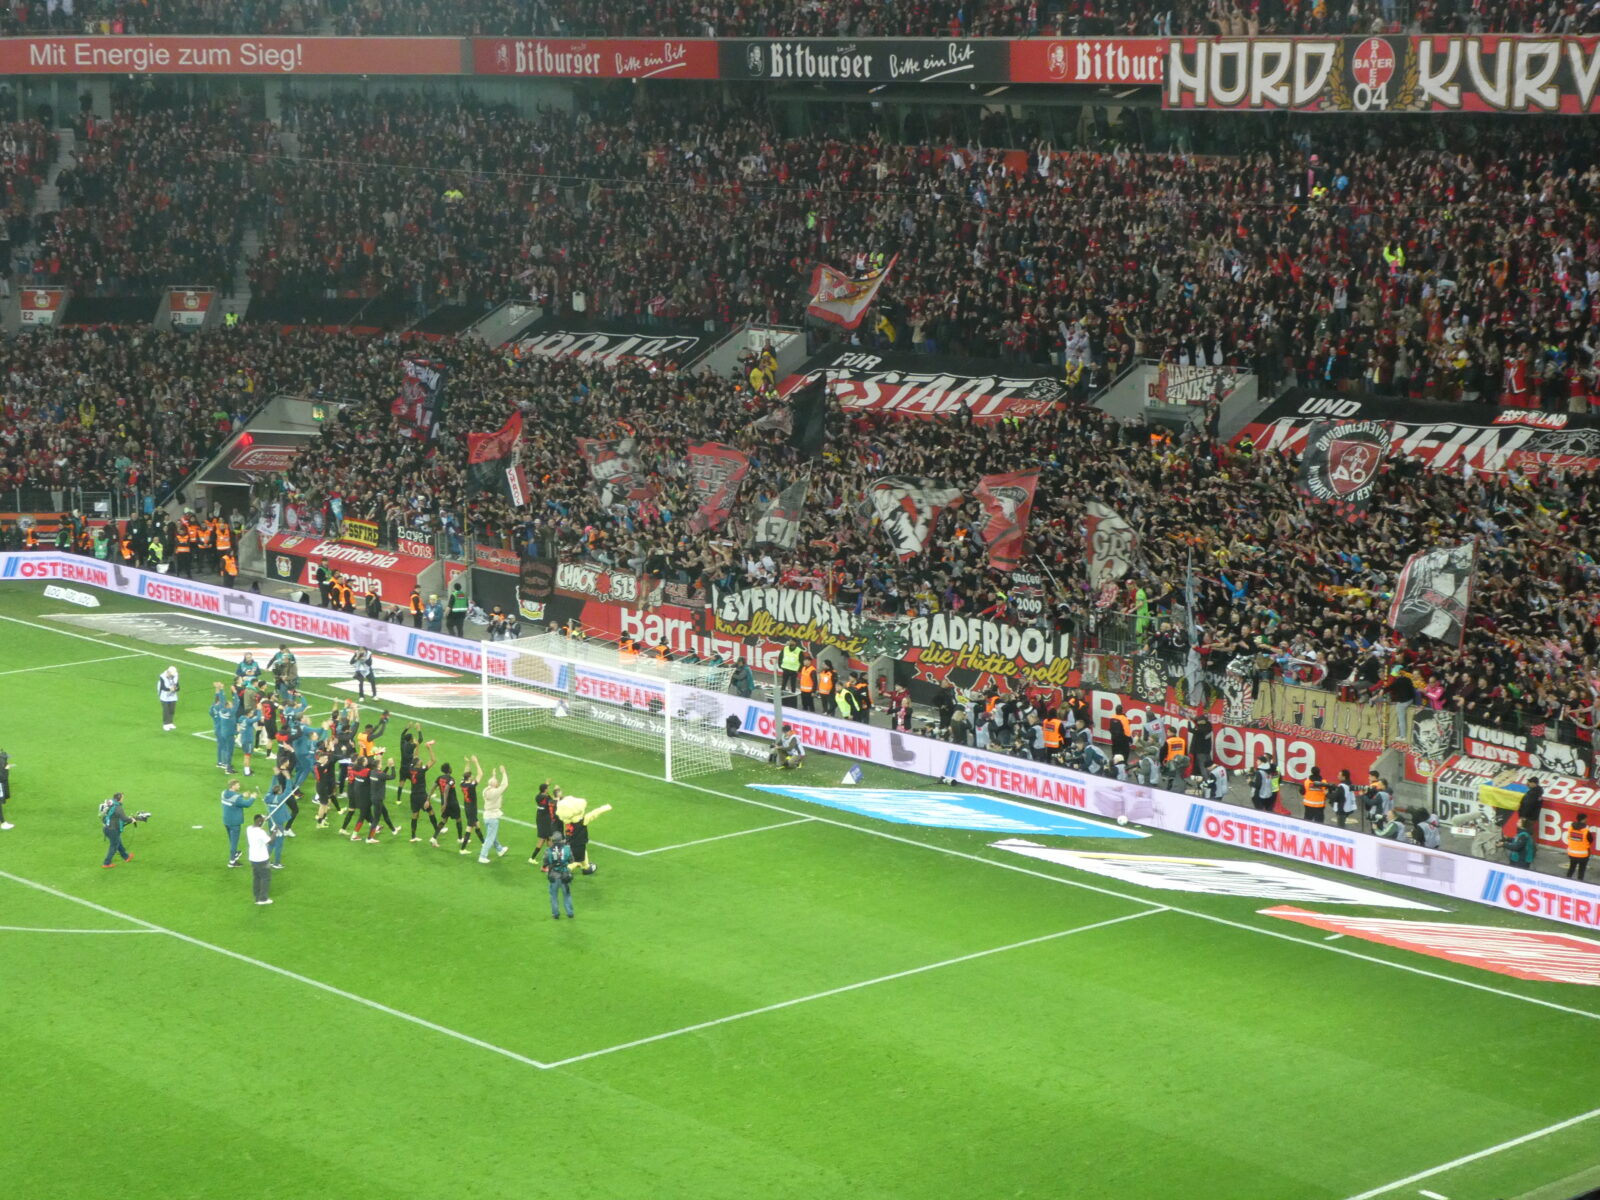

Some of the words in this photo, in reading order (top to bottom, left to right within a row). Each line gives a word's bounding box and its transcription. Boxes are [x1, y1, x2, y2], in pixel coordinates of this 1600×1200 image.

[30, 44, 66, 66] Mit
[75, 43, 170, 70] Energie
[178, 48, 231, 66] zum
[239, 43, 303, 71] Sieg!
[515, 41, 600, 75] Bitburger
[615, 52, 641, 75] Bitte
[644, 56, 664, 67] ein
[664, 42, 687, 62] Bit
[770, 42, 873, 78] Bitburger
[889, 54, 921, 78] Bitte
[923, 58, 947, 71] ein
[948, 42, 974, 65] Bit
[1074, 42, 1164, 81] Bitbur
[1353, 58, 1393, 69] BAYER
[1168, 40, 1338, 107] NORD
[1353, 82, 1389, 110] 04
[832, 351, 883, 370] FÜR
[1297, 397, 1362, 418] UND
[310, 540, 399, 569] Barmenia
[21, 562, 108, 587] OSTERMANN
[147, 582, 221, 613] OSTERMANN
[1015, 598, 1042, 614] 2009
[269, 609, 350, 642] OSTERMANN
[960, 760, 1086, 809] OSTERMANN
[1205, 815, 1355, 870] OSTERMANN
